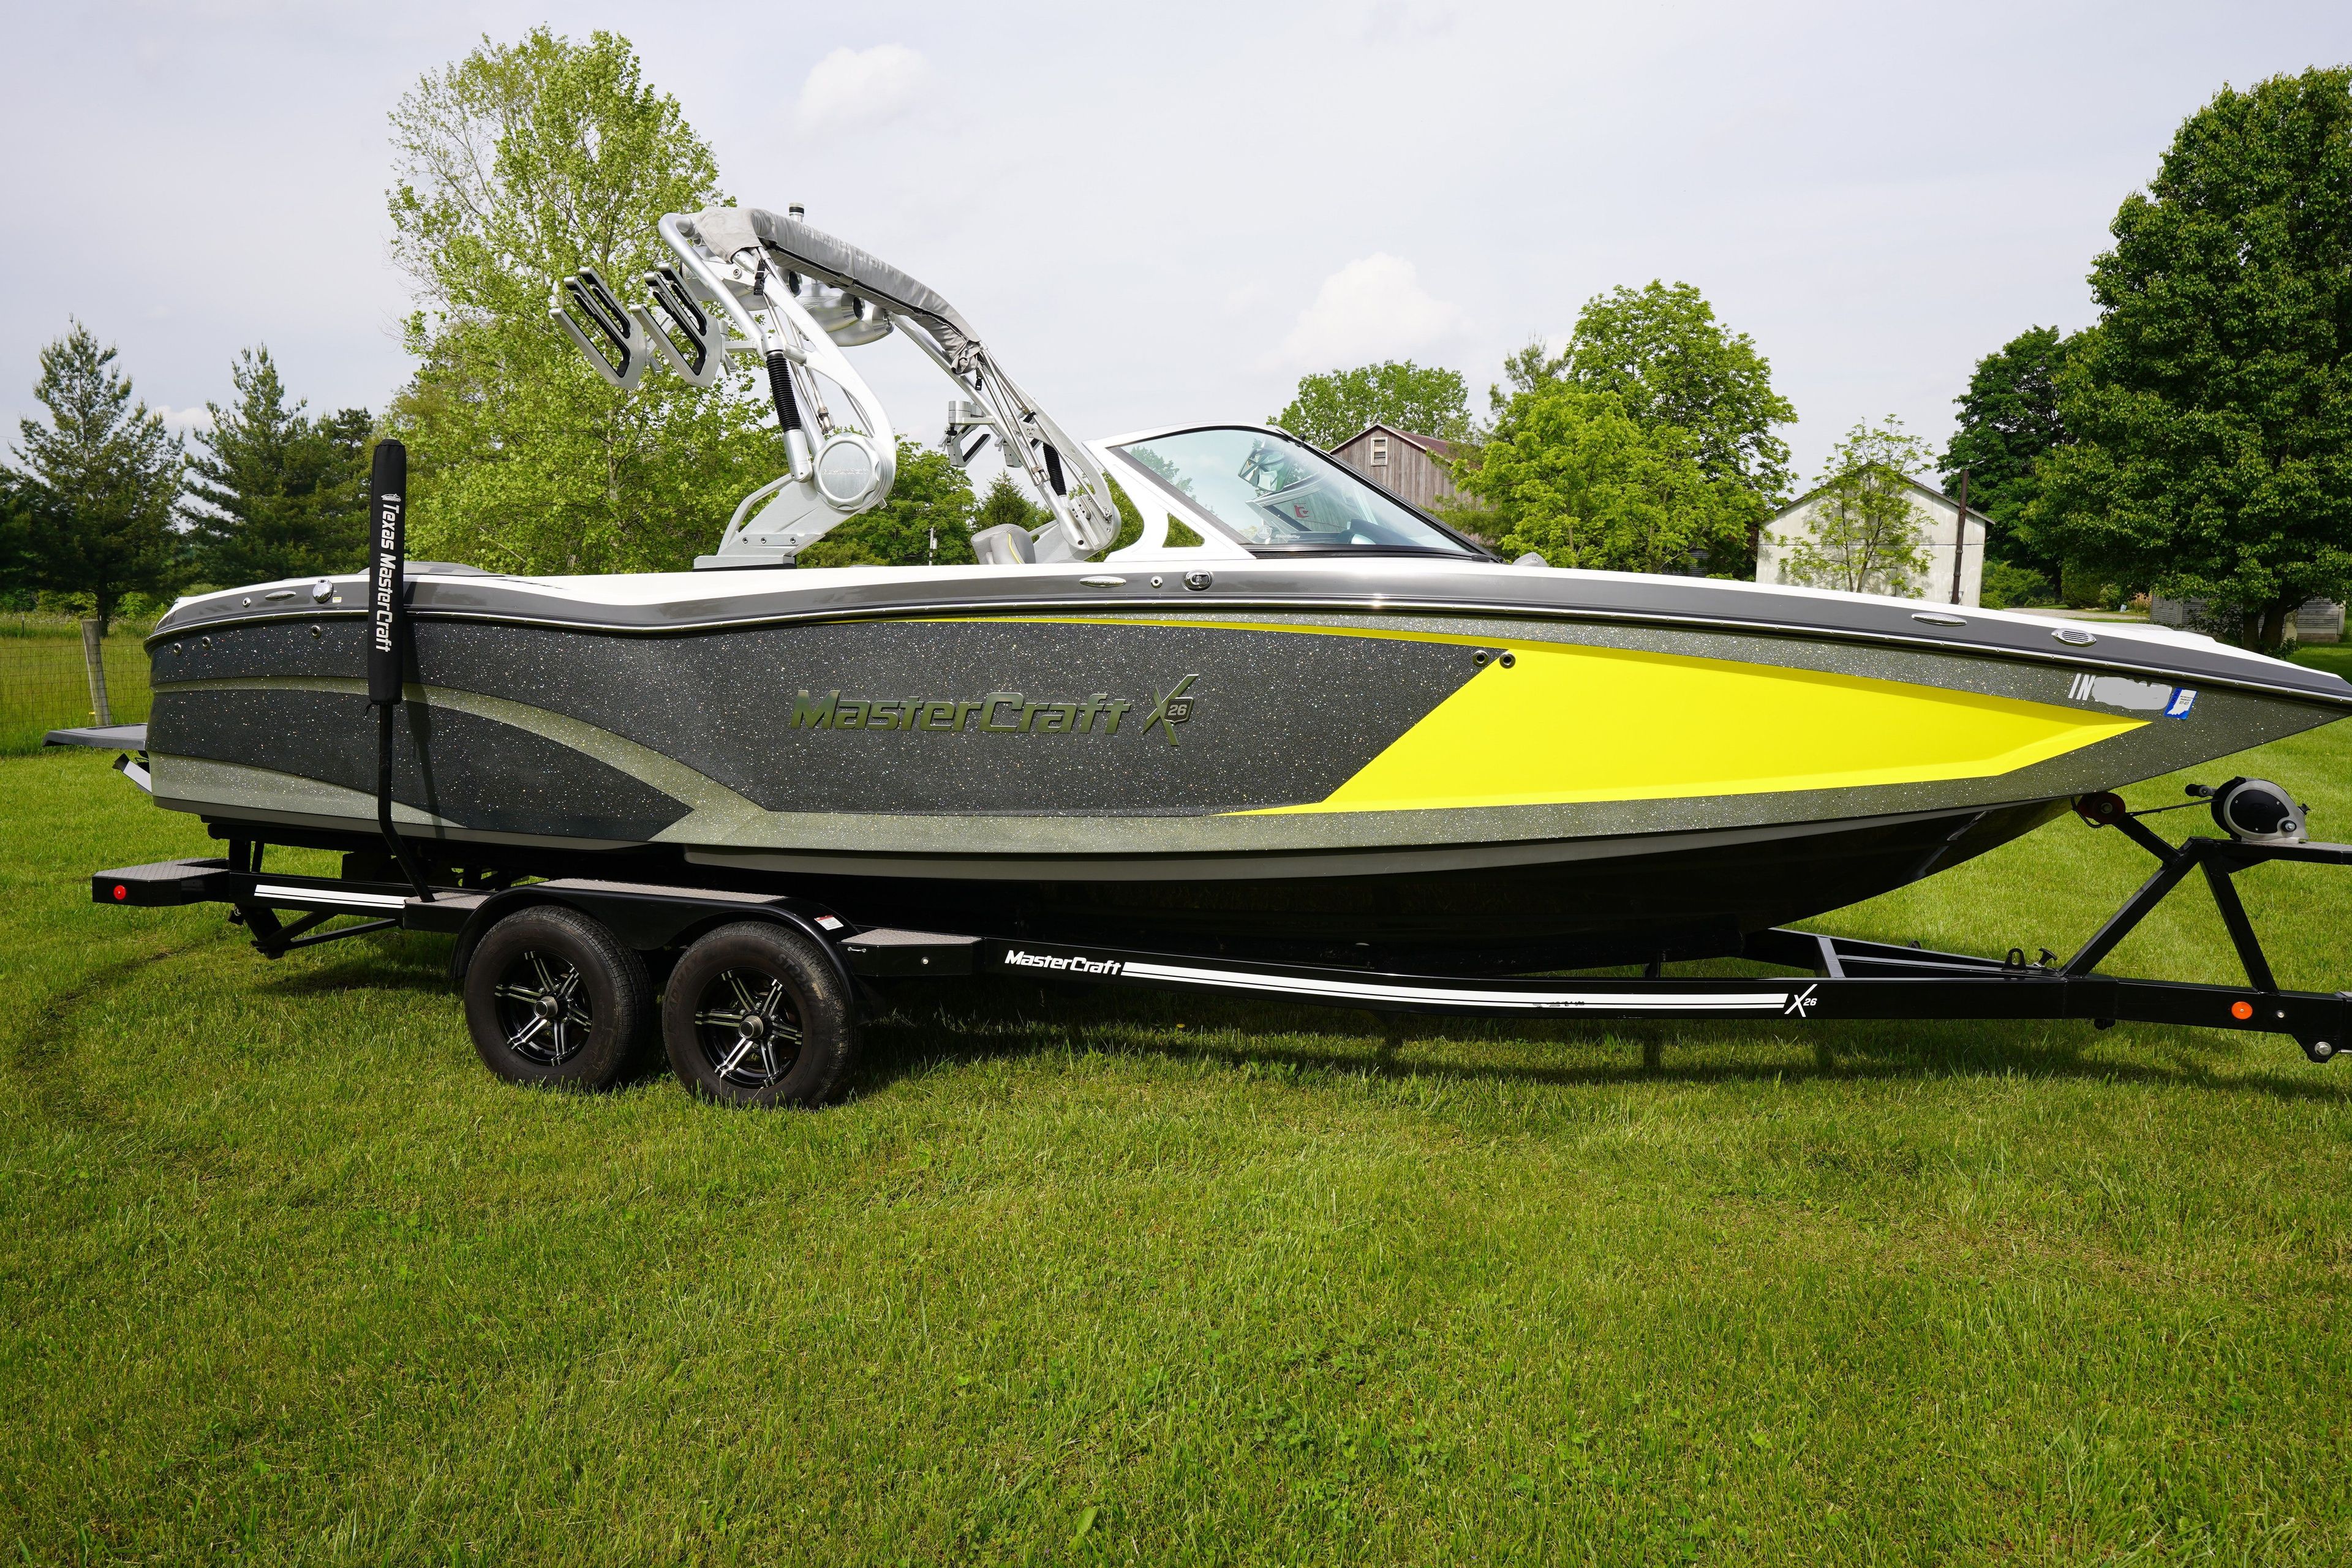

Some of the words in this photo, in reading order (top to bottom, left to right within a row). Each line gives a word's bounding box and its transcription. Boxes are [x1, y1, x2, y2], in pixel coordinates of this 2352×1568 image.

[381, 504, 399, 550] Texas
[375, 552, 397, 652] MasterCraft
[2068, 673, 2096, 701] IN
[790, 690, 1131, 735] MasterCraft
[1004, 949, 1121, 975] MasterCraft
